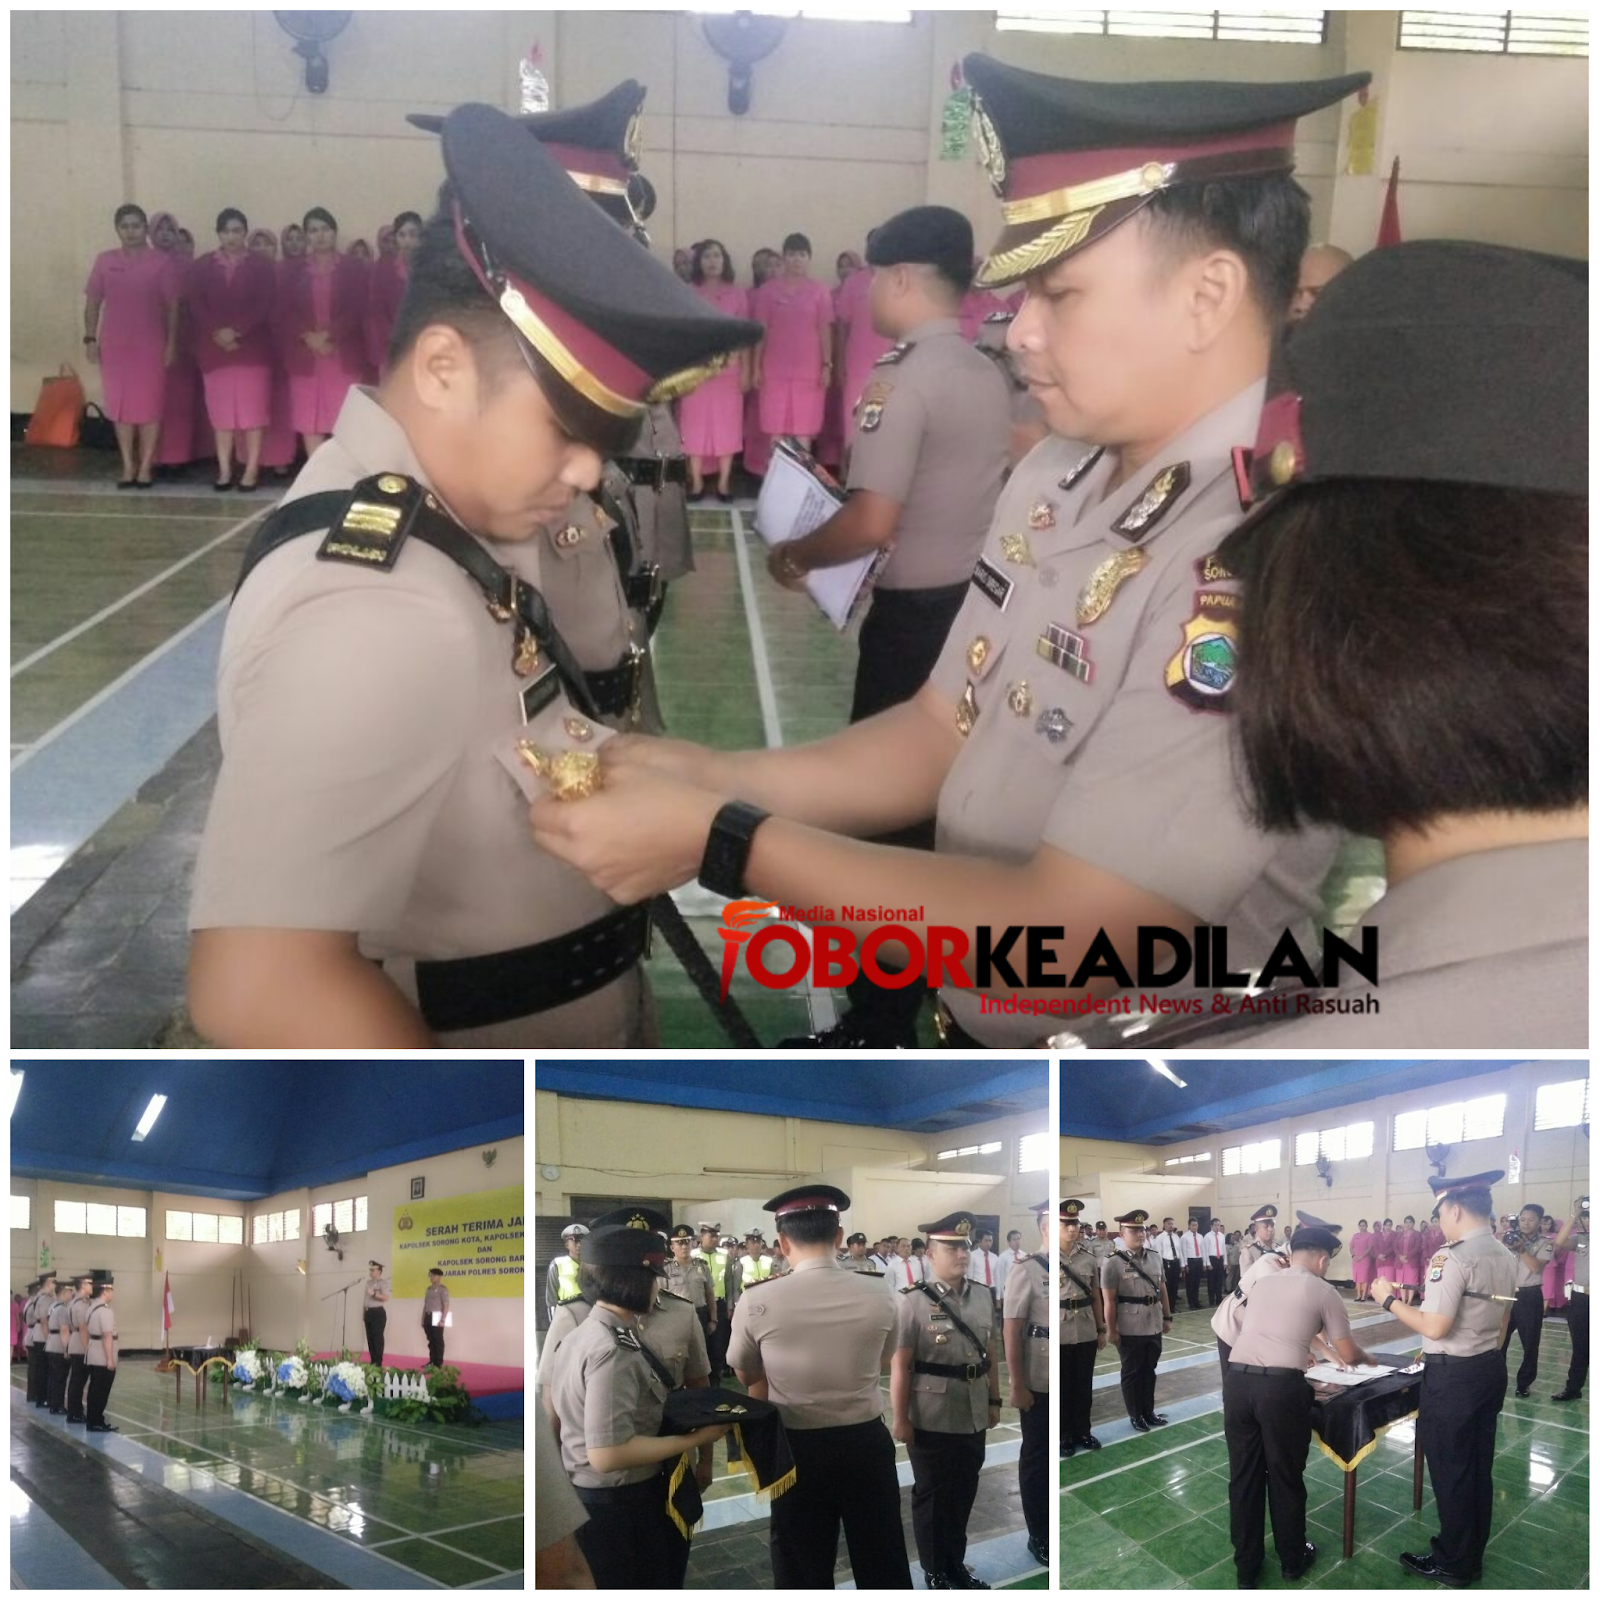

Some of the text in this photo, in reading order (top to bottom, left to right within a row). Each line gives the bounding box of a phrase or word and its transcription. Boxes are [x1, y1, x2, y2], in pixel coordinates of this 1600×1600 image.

[425, 1215, 524, 1237] SERAH TERIMA JA
[400, 1241, 431, 1250] KAPOLSEK
[432, 1237, 460, 1247] SORONG
[461, 1236, 483, 1244] KOTA,
[477, 1246, 493, 1254] DAN
[437, 1258, 473, 1267] KAPOLSEK
[475, 1256, 507, 1265] SORONG
[468, 1268, 497, 1276] POLRES
